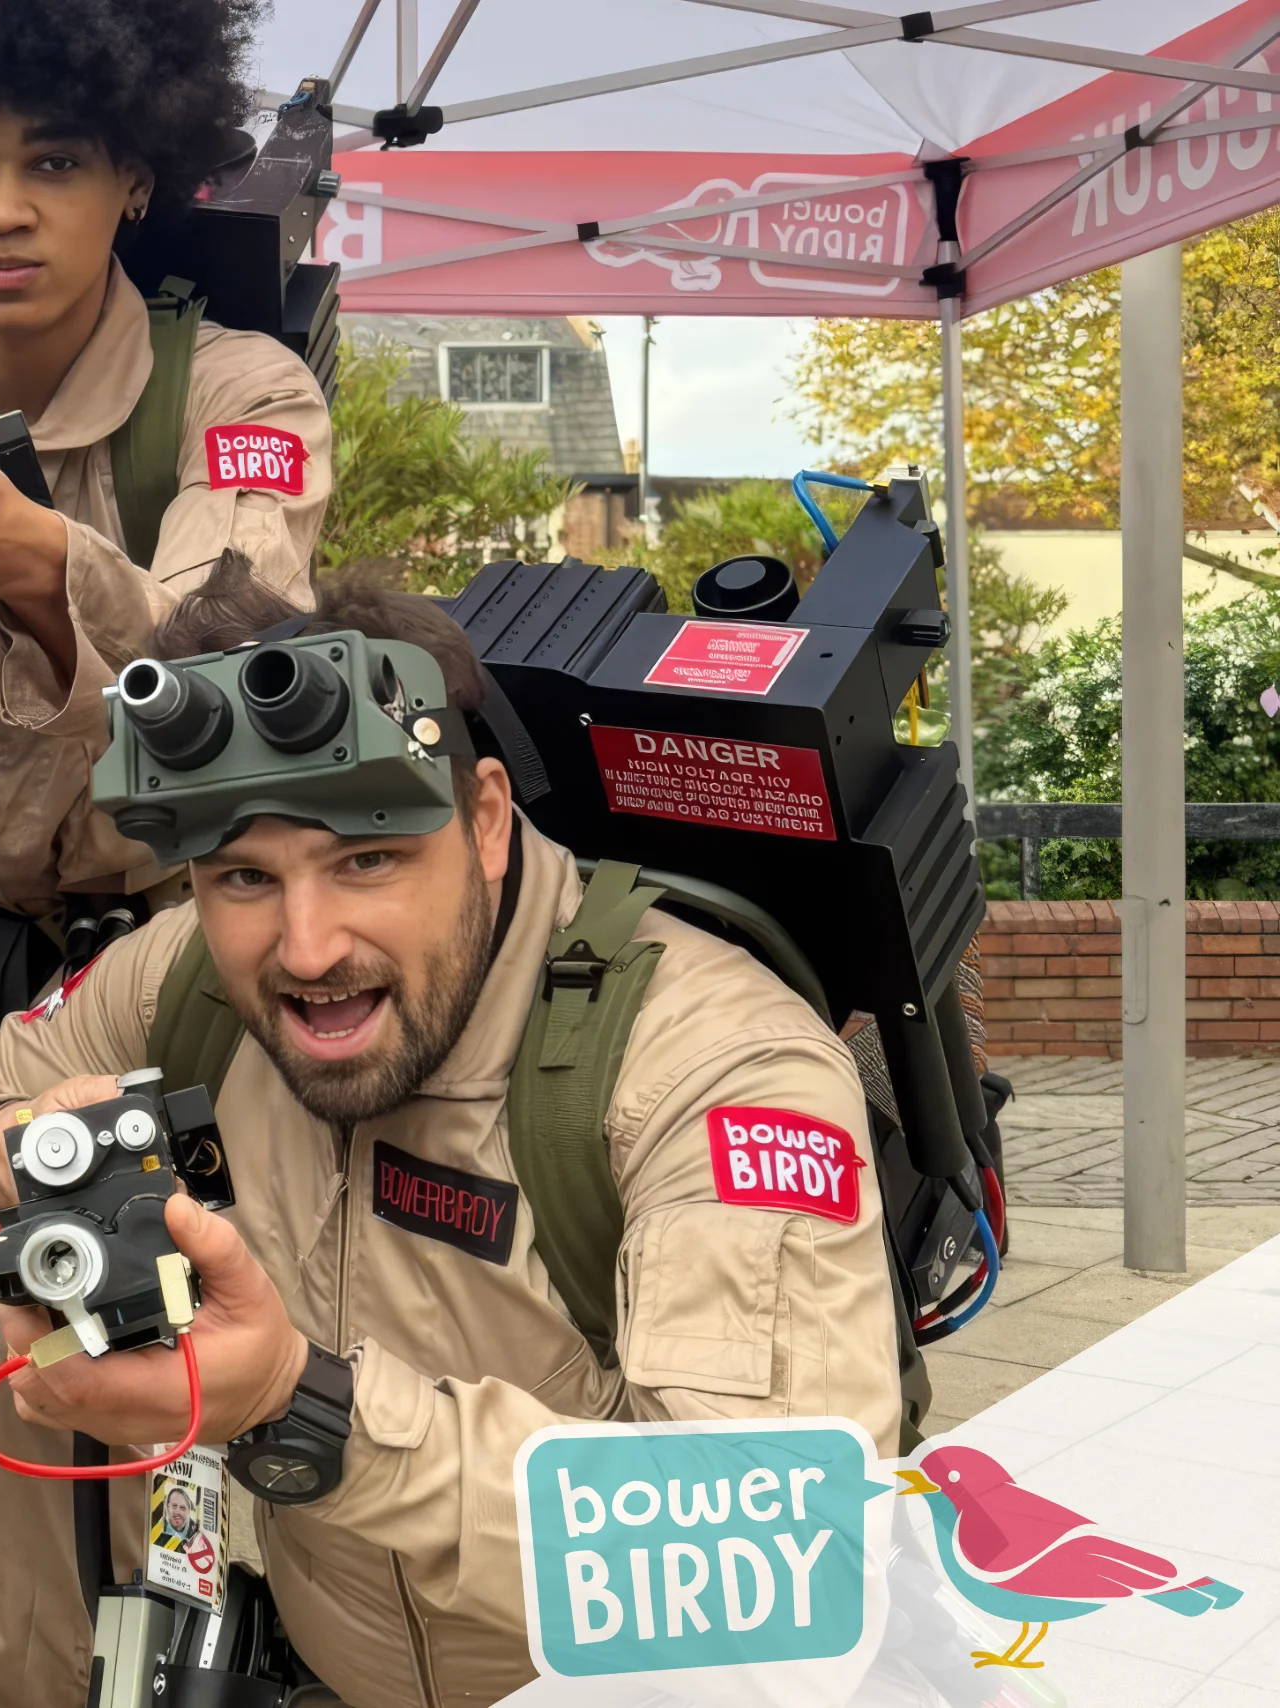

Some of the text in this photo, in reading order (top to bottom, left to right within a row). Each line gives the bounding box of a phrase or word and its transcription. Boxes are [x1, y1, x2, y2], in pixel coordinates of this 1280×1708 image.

[215, 433, 294, 457] bower
[218, 451, 295, 484] BIRDY
[634, 733, 781, 771] DANGER
[722, 1117, 842, 1160] bower
[727, 1148, 846, 1204] BIRDY
